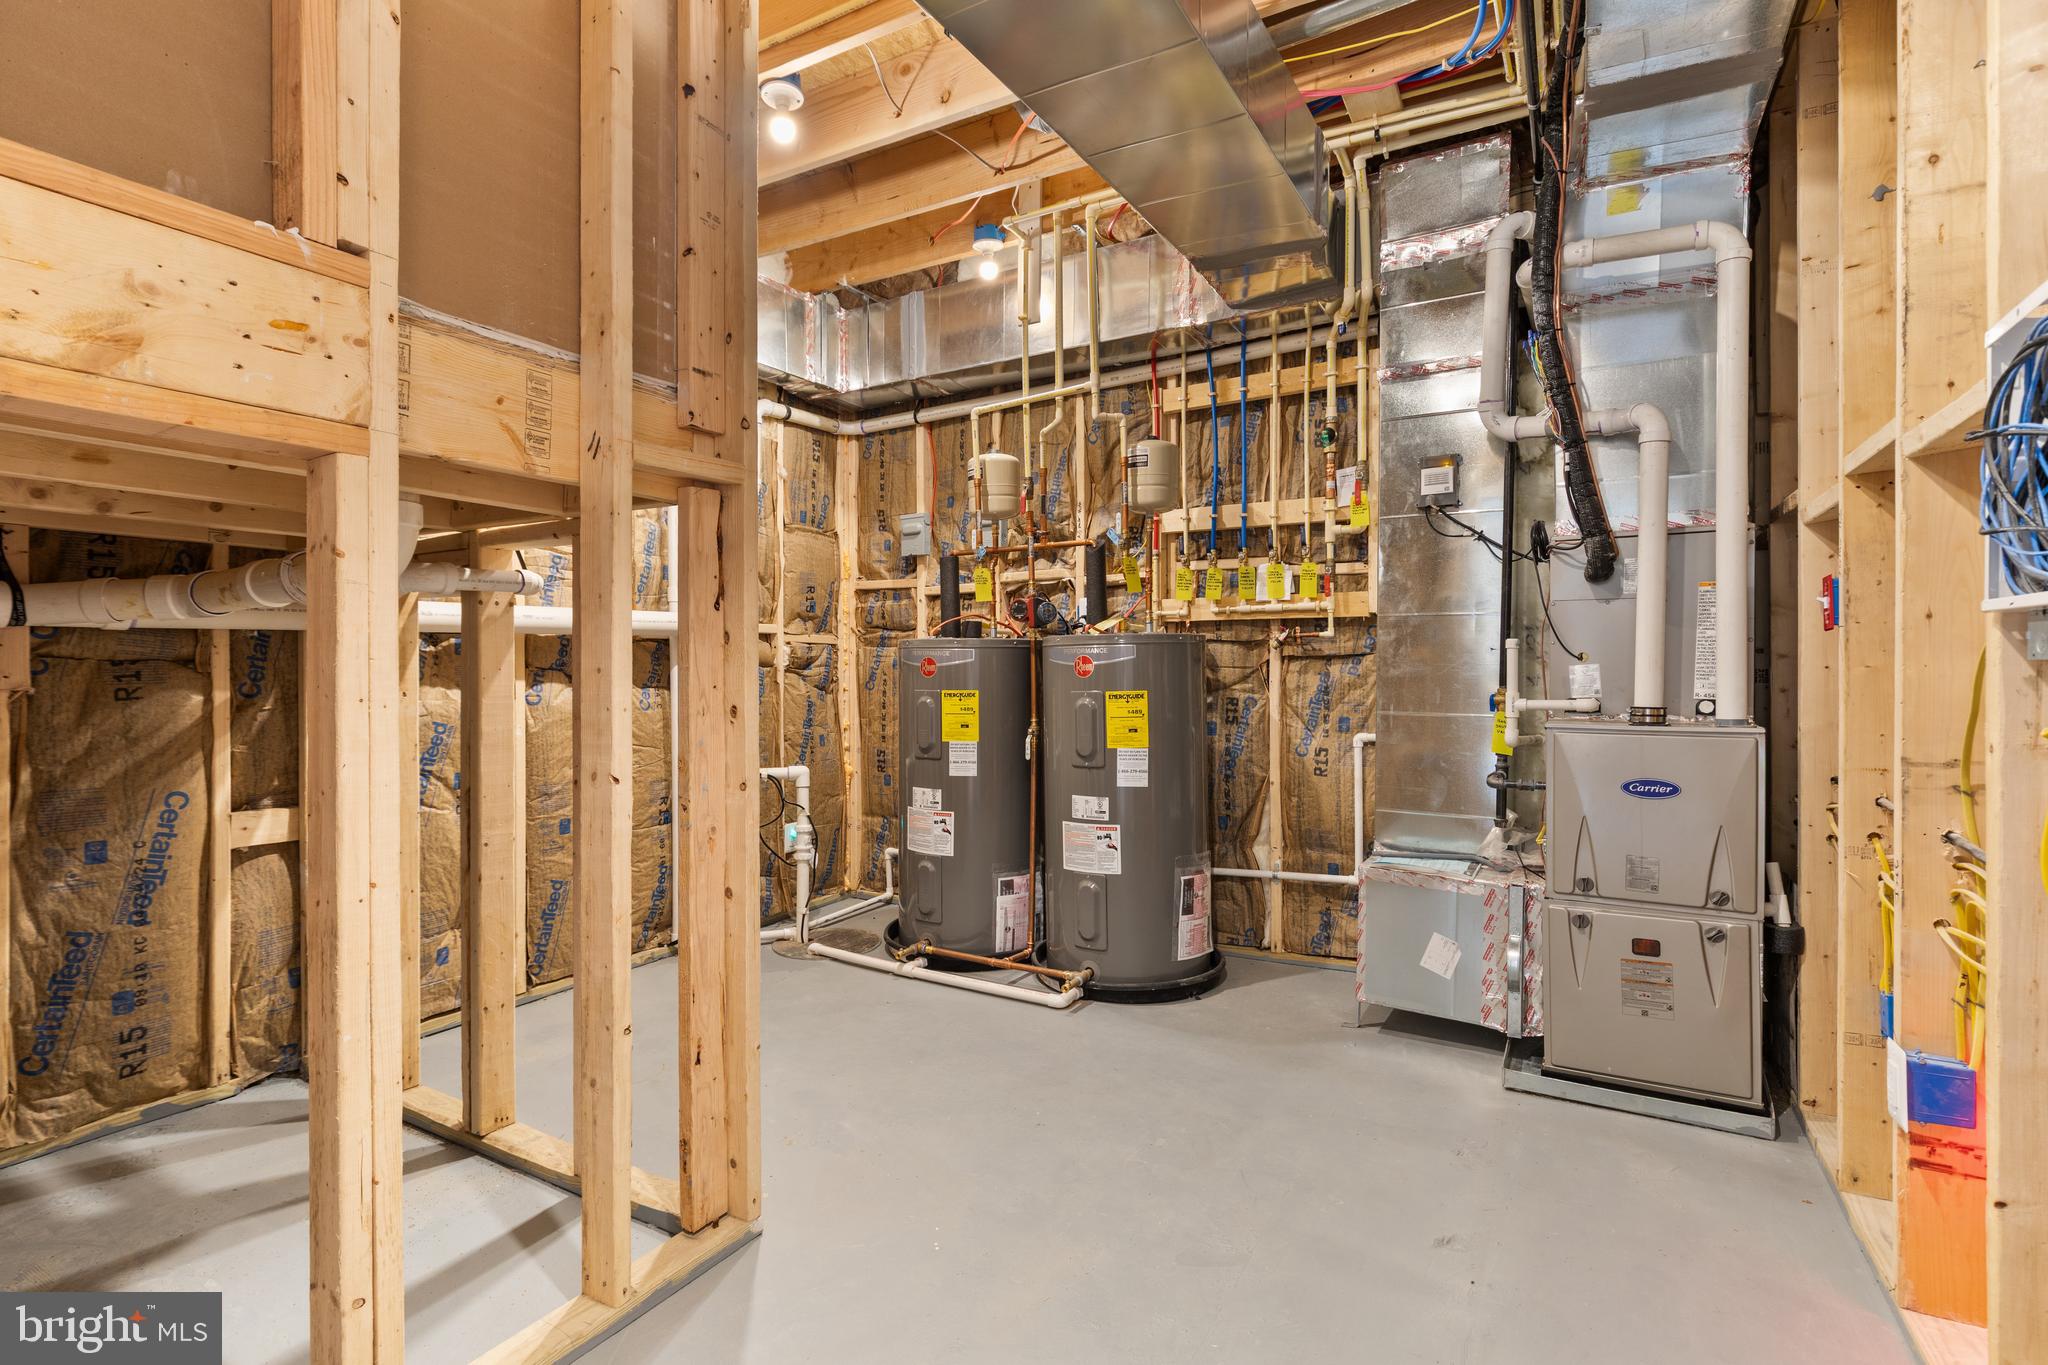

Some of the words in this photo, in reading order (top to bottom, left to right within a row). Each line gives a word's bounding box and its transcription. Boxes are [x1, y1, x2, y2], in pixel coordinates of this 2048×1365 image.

[812, 438, 821, 464] R15
[816, 494, 830, 529] Certai
[876, 509, 888, 532] R15
[237, 628, 272, 701] Certain
[1074, 655, 1094, 675] Rheem
[1225, 697, 1239, 725] R15
[877, 748, 886, 773] R15
[1313, 747, 1329, 777] R15
[1629, 783, 1673, 795] Carrier
[126, 790, 190, 928] CertainTeed
[528, 879, 564, 977] CertainTeed
[17, 930, 93, 1077] CertainTeed
[116, 1023, 149, 1081] R15
